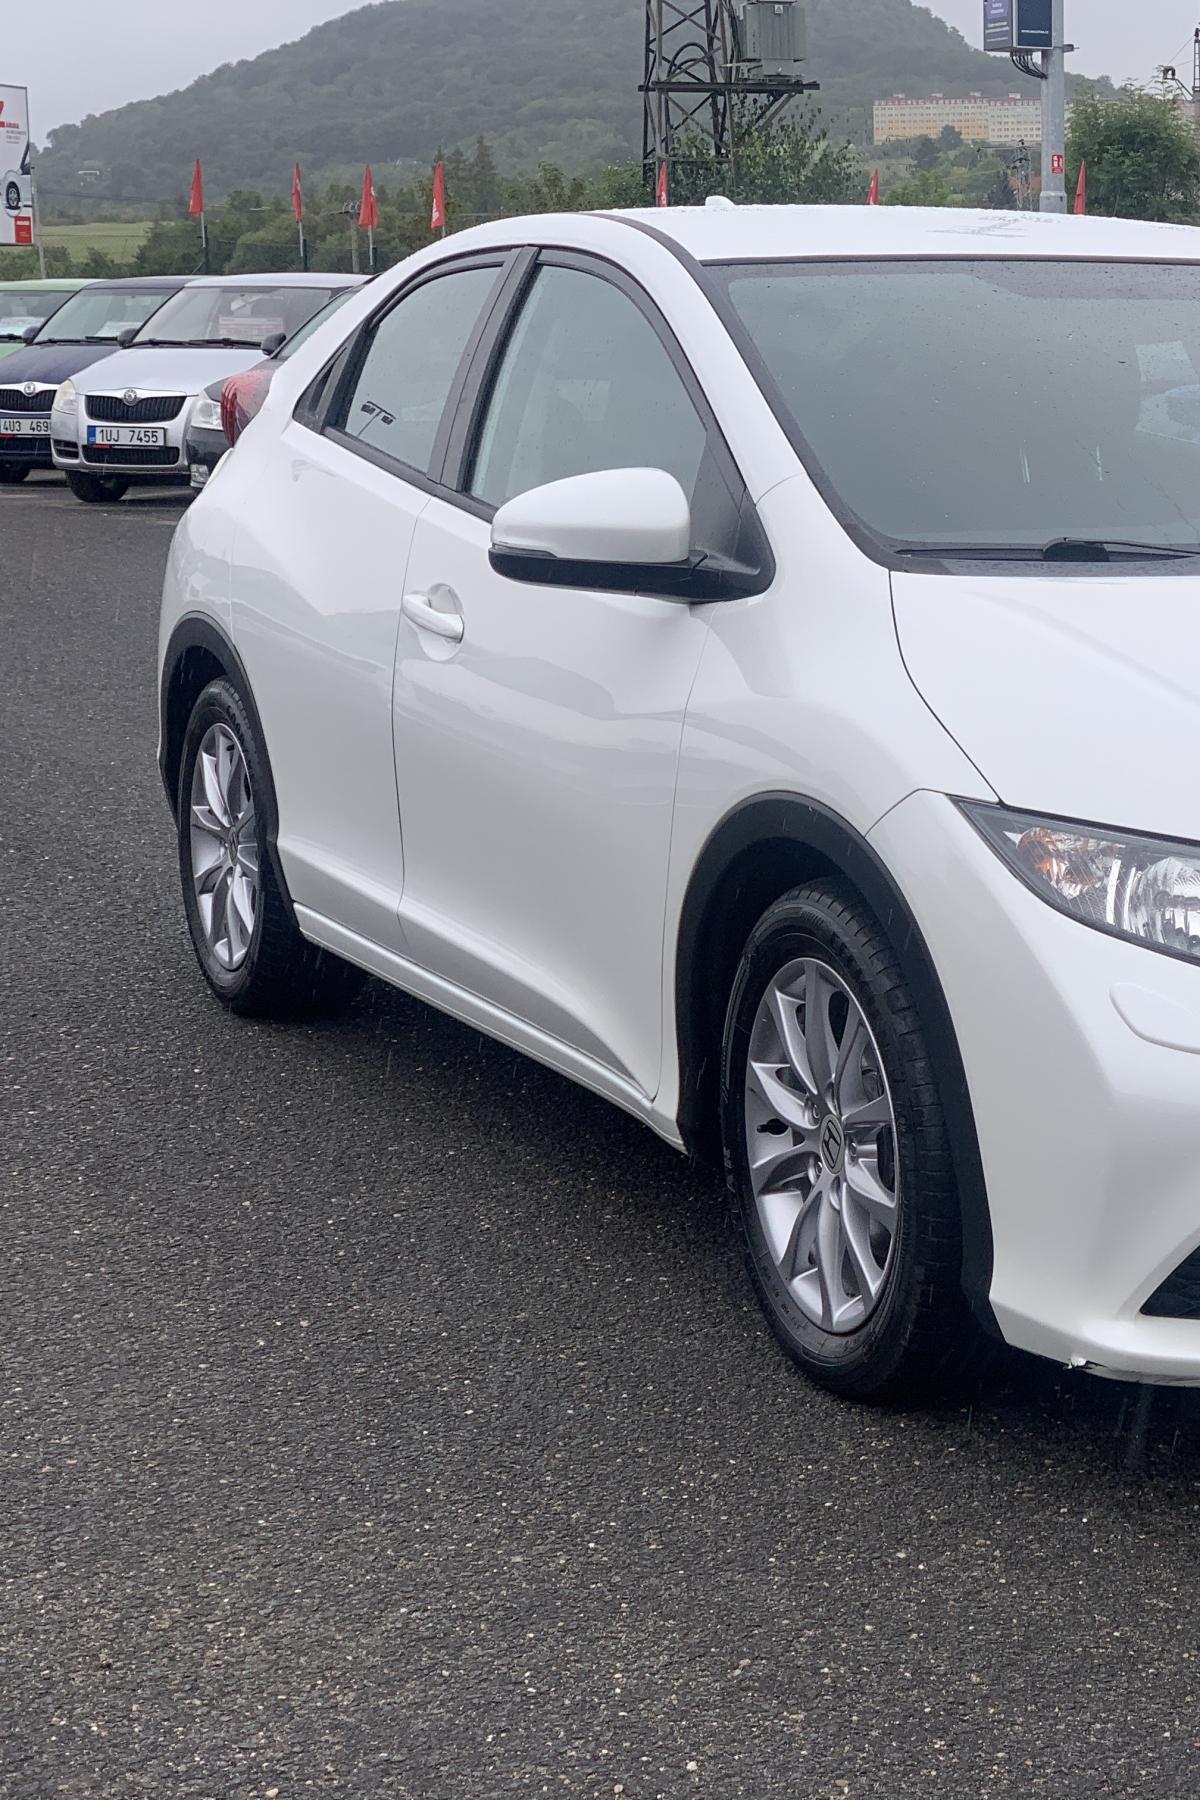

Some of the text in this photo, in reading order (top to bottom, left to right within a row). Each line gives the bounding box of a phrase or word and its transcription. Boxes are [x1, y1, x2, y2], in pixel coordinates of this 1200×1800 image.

[29, 420, 51, 433] 469
[99, 429, 120, 442] 1UJ
[129, 430, 159, 443] 7455
